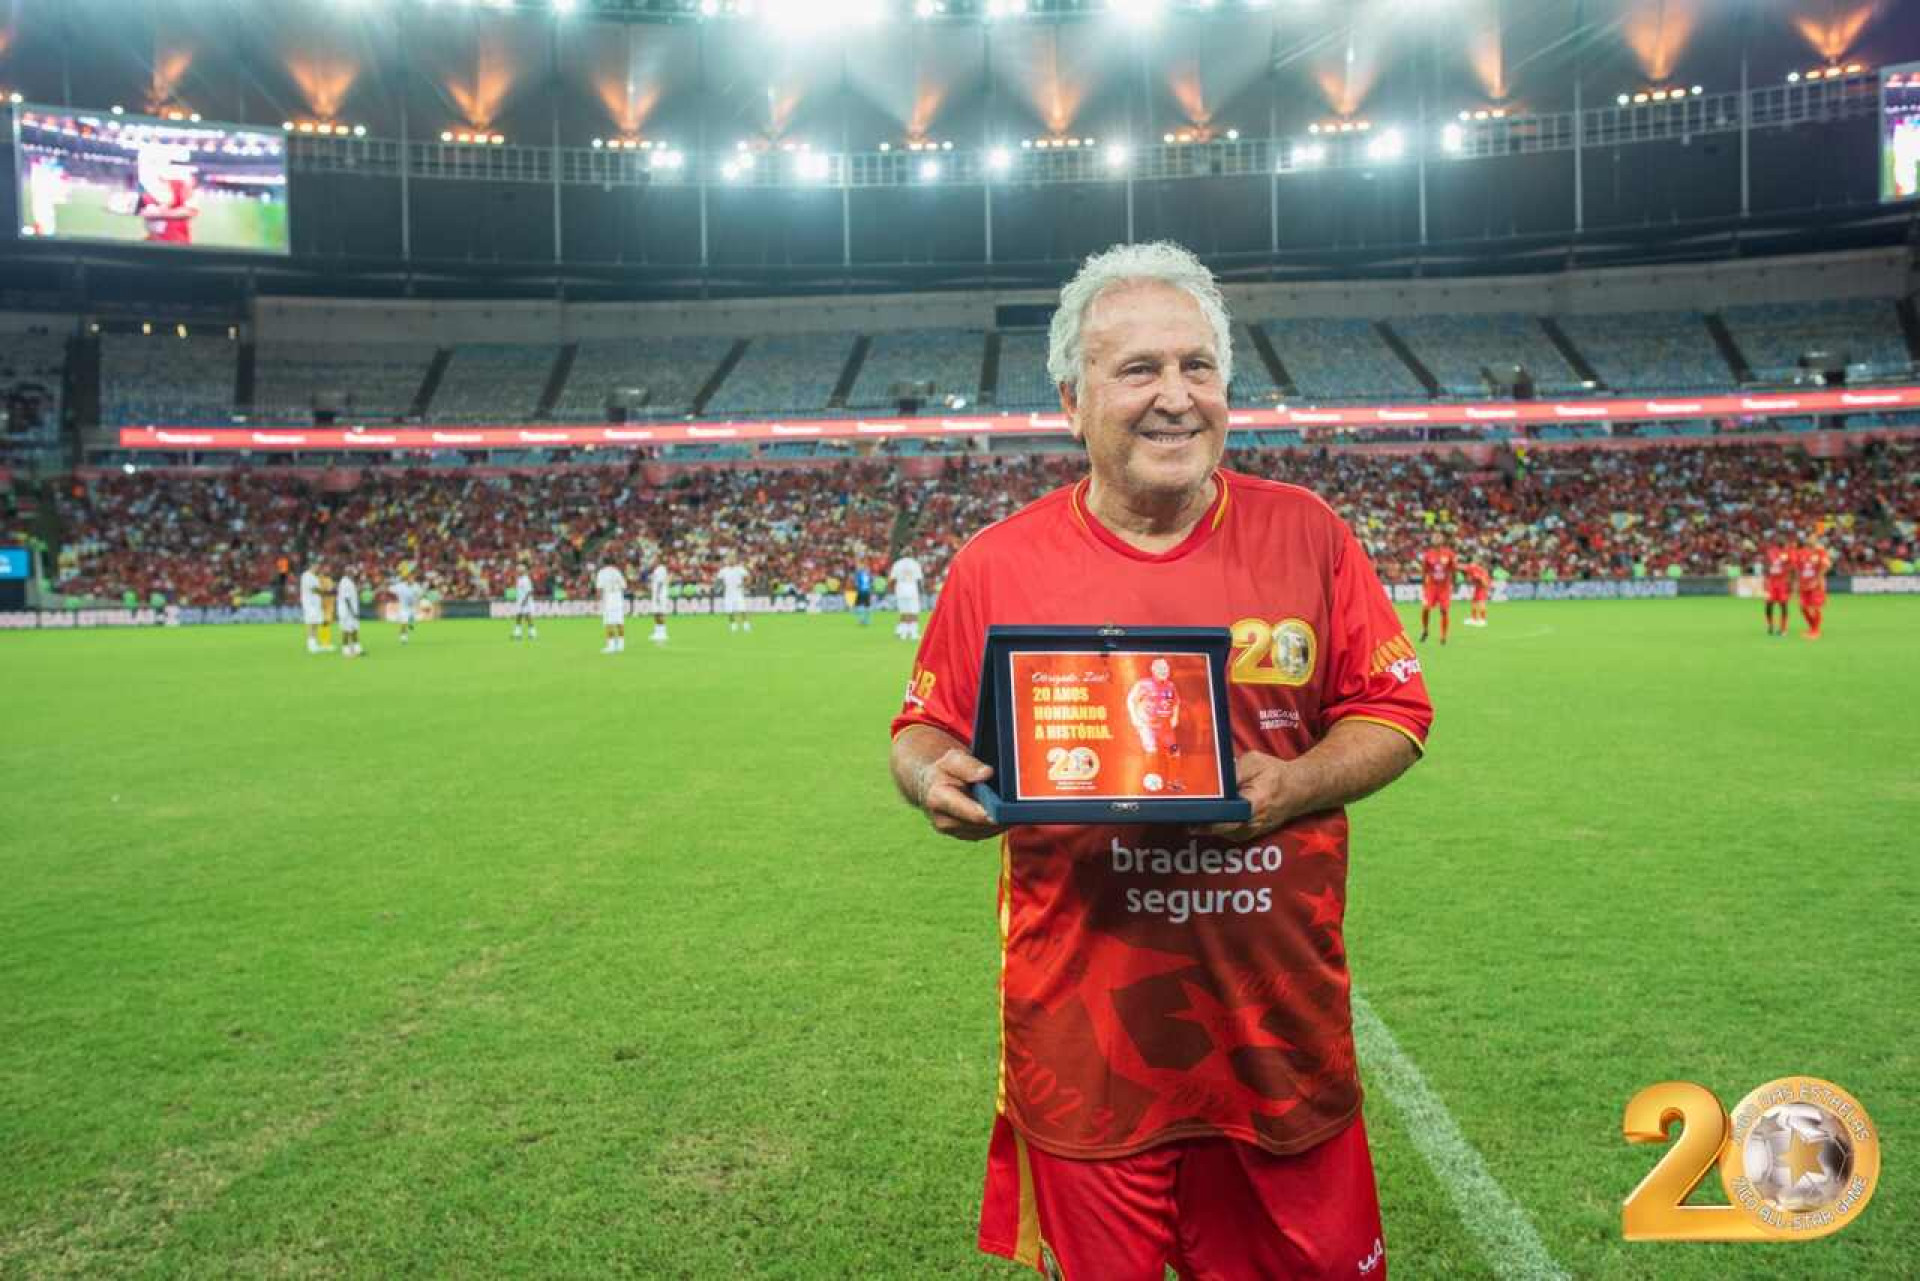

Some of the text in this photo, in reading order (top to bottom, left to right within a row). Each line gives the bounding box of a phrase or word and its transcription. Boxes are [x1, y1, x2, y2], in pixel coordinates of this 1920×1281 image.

[1230, 617, 1317, 686] 20
[1032, 686, 1089, 702] 20 ANOS
[1034, 705, 1107, 721] HONRANDO
[1034, 724, 1044, 739] A
[1046, 746, 1100, 781] 20
[1111, 836, 1282, 873] bradesco
[1126, 887, 1273, 923] seguros
